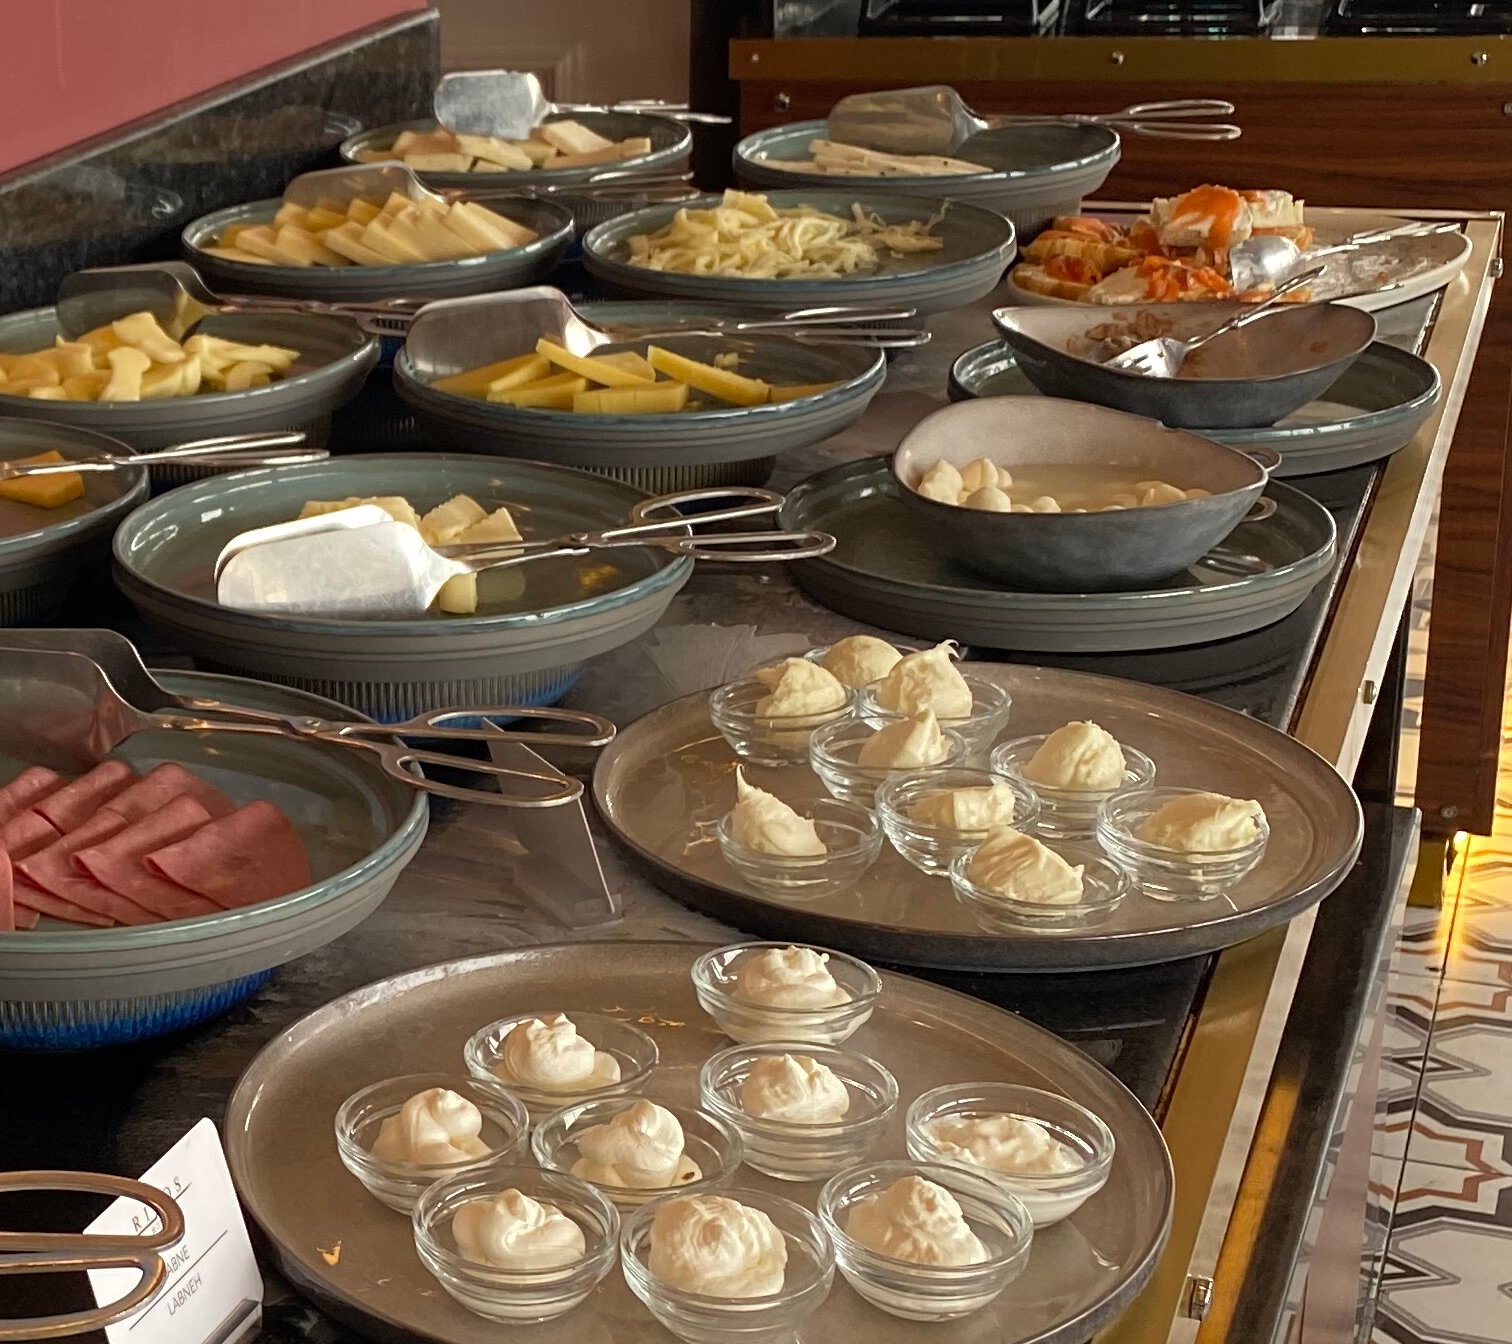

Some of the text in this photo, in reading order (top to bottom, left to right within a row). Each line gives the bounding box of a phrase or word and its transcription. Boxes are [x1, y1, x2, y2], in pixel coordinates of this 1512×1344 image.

[131, 1176, 182, 1233] RIS
[166, 1244, 191, 1277] ABNE
[166, 1272, 203, 1316] LABNEH
